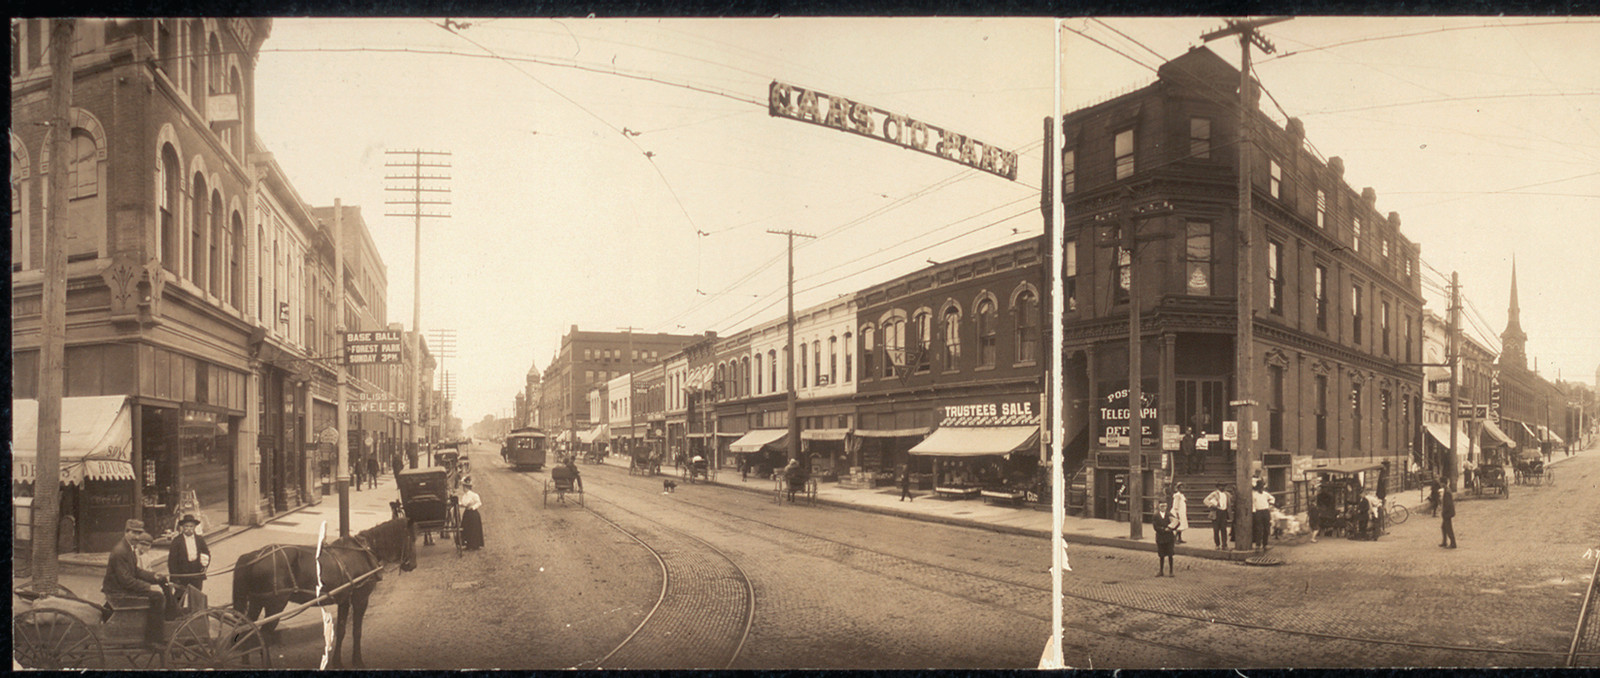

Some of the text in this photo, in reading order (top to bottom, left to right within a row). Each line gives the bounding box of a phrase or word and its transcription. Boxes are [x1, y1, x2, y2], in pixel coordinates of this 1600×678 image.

[772, 82, 875, 135] CARS
[886, 111, 929, 150] TO
[347, 332, 400, 342] BASE BALL
[351, 344, 379, 353] FOREST
[381, 343, 401, 353] PARK
[349, 354, 377, 363] SUNDAY
[894, 352, 916, 364] K P
[346, 402, 406, 412] JEWELER
[944, 402, 1032, 417] TRUSTEES SALE
[1100, 408, 1157, 420] TELEGAPH
[99, 461, 129, 475] DRUGS
